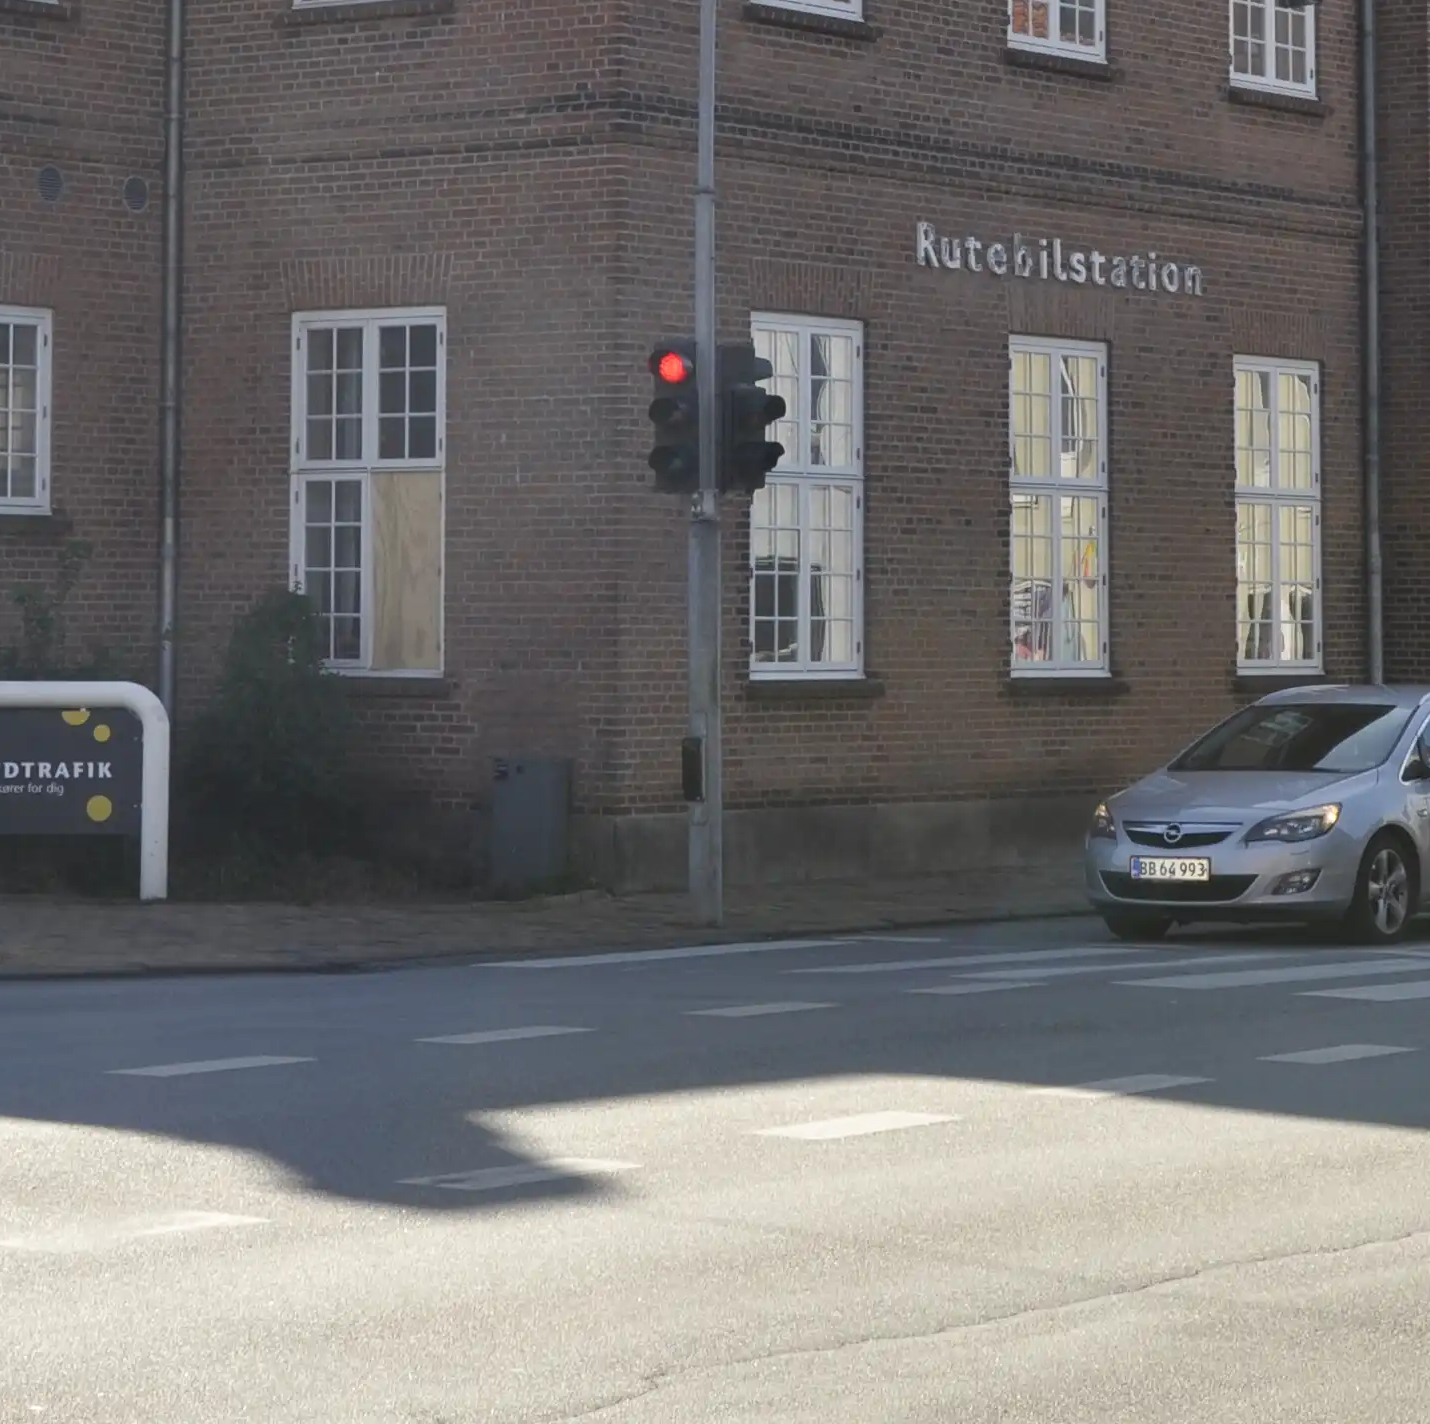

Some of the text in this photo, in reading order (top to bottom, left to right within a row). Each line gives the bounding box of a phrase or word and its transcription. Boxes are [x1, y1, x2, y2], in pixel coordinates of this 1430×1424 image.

[916, 221, 1203, 296] Rutebilstation
[27, 782, 43, 793] for
[46, 782, 64, 797] dig
[1140, 861, 1205, 877] BB 64 993
